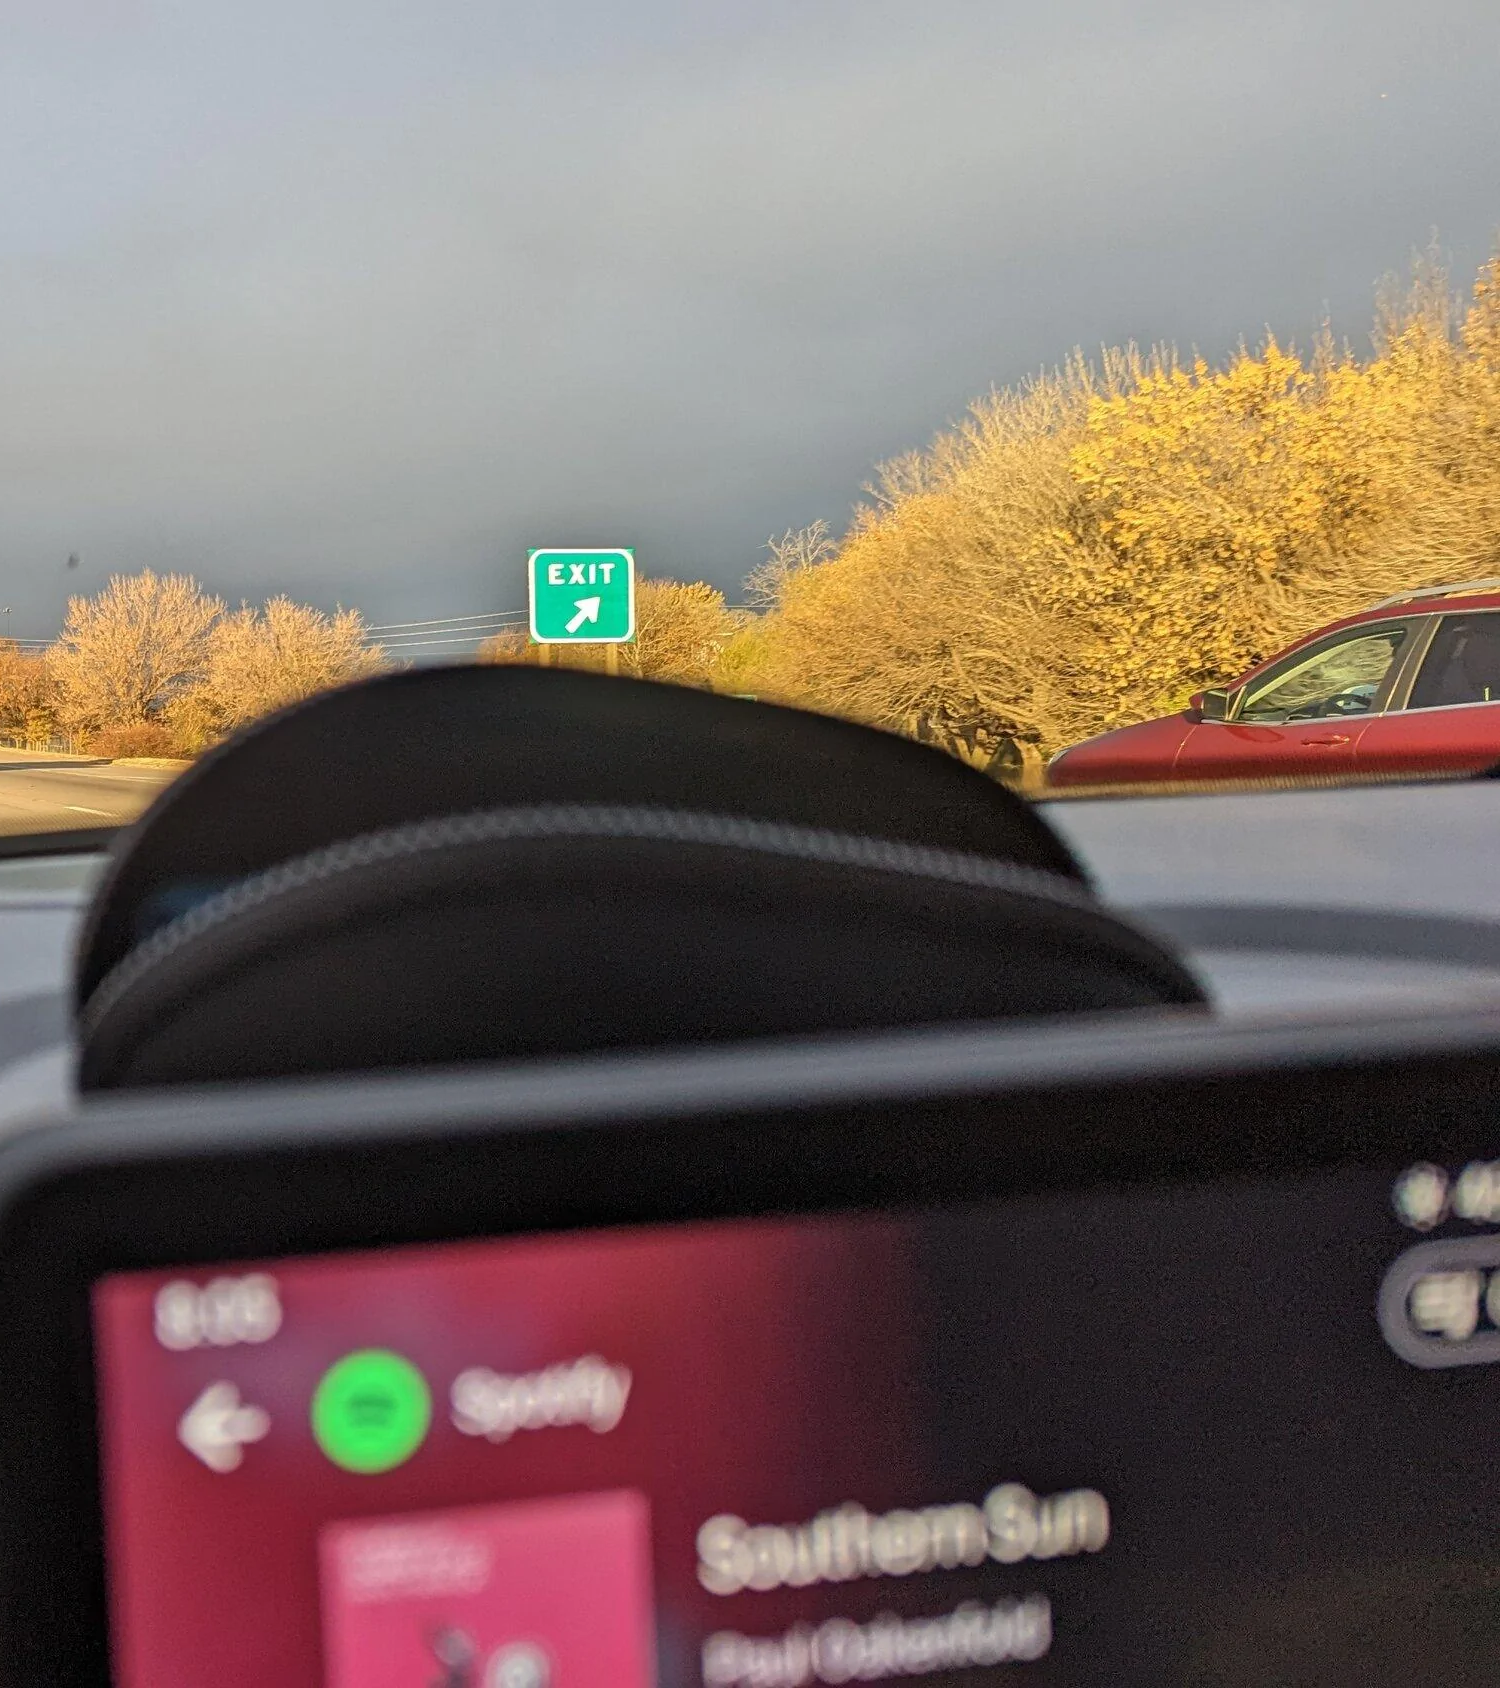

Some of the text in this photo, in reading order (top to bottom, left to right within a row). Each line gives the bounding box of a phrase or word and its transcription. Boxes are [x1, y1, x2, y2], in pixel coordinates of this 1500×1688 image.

[547, 563, 616, 585] EXIT
[451, 1354, 633, 1442] Spotify
[697, 1482, 1111, 1596] Southern Sun
